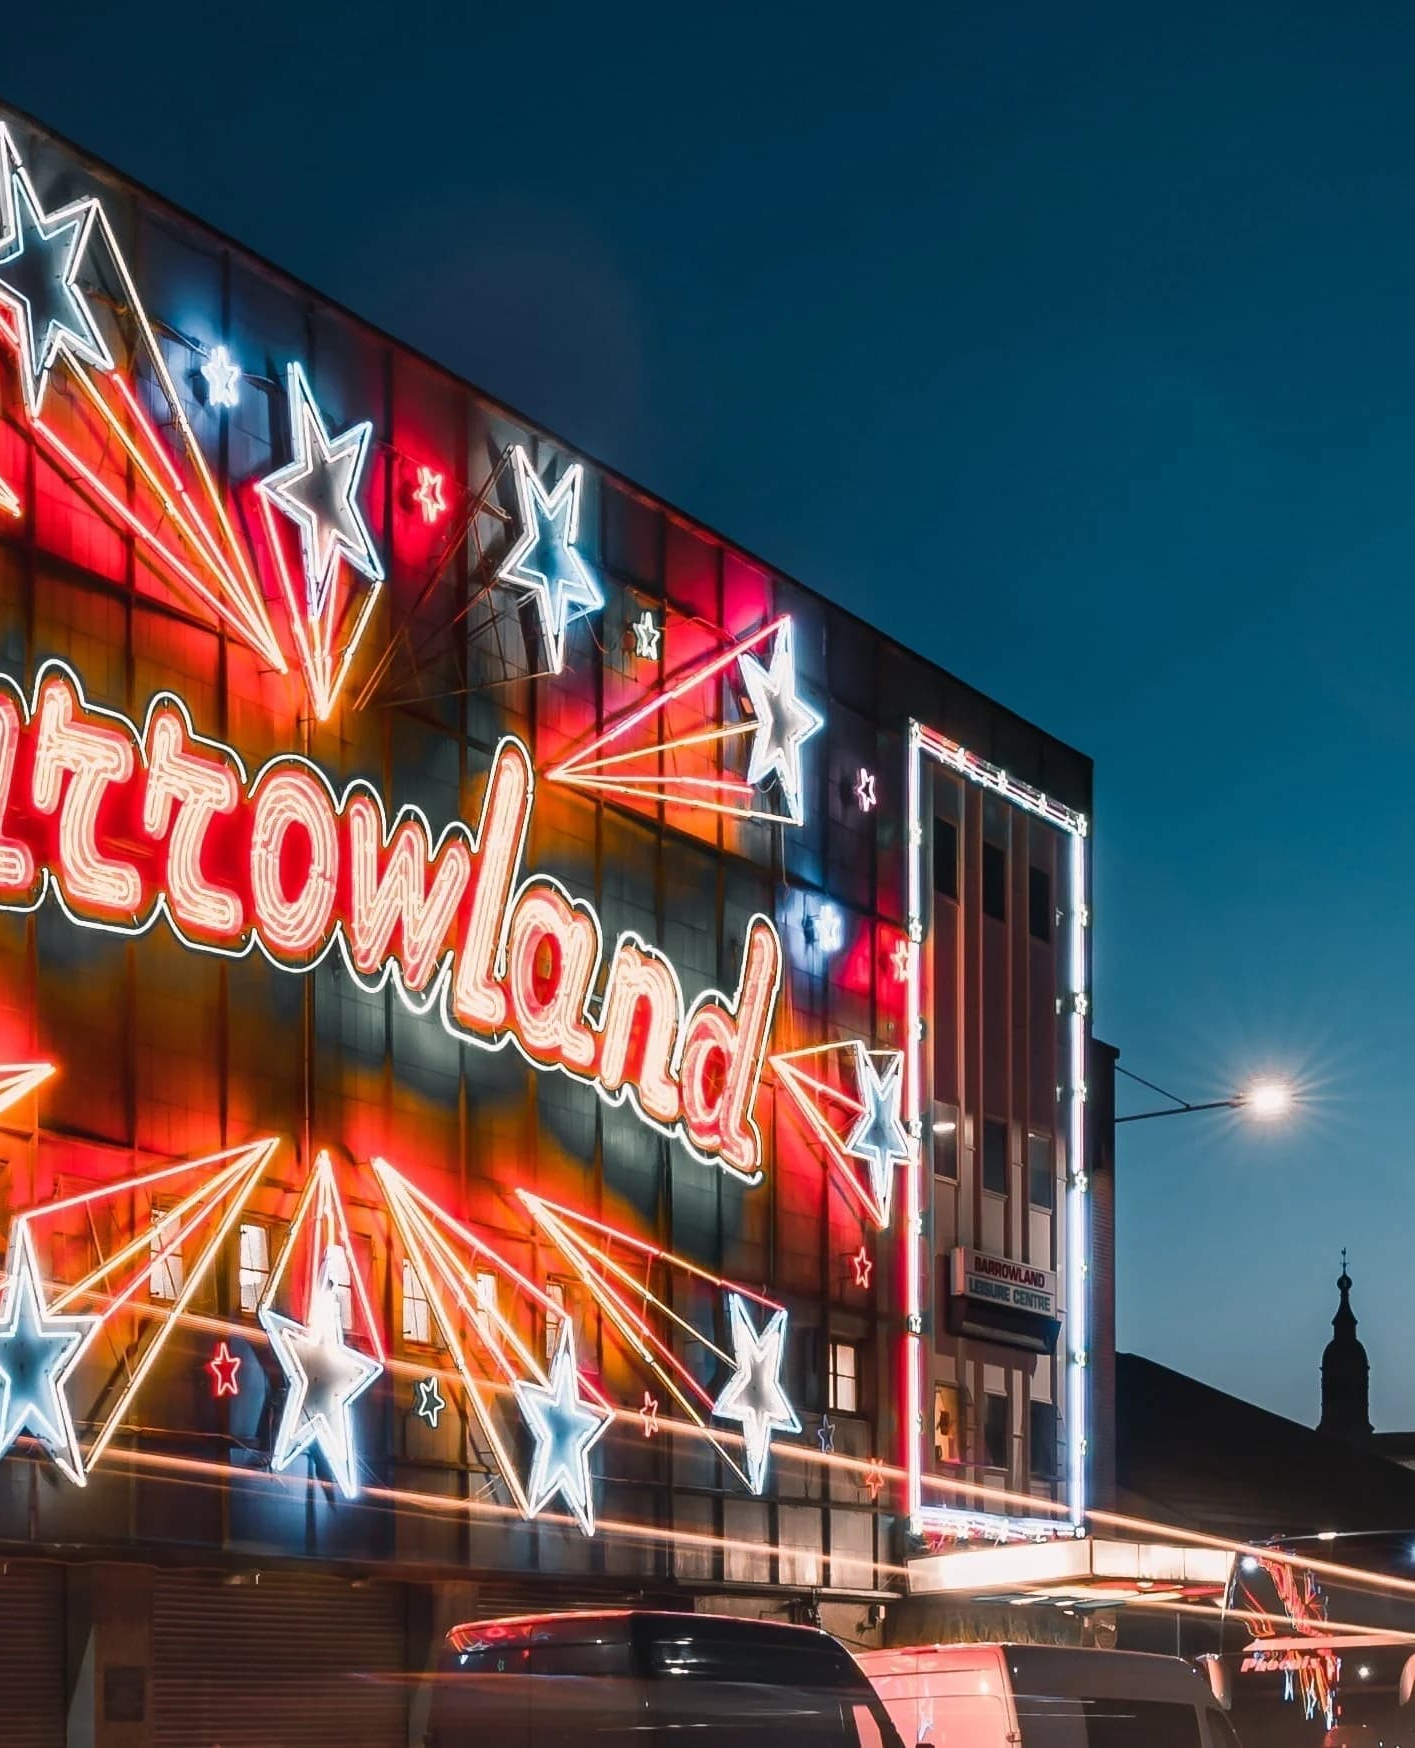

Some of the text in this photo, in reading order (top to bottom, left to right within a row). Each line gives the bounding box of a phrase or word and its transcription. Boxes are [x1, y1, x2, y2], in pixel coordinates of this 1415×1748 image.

[973, 1255, 1046, 1288] BARROWLAND
[968, 1277, 1051, 1312] LEISURE CENTRE
